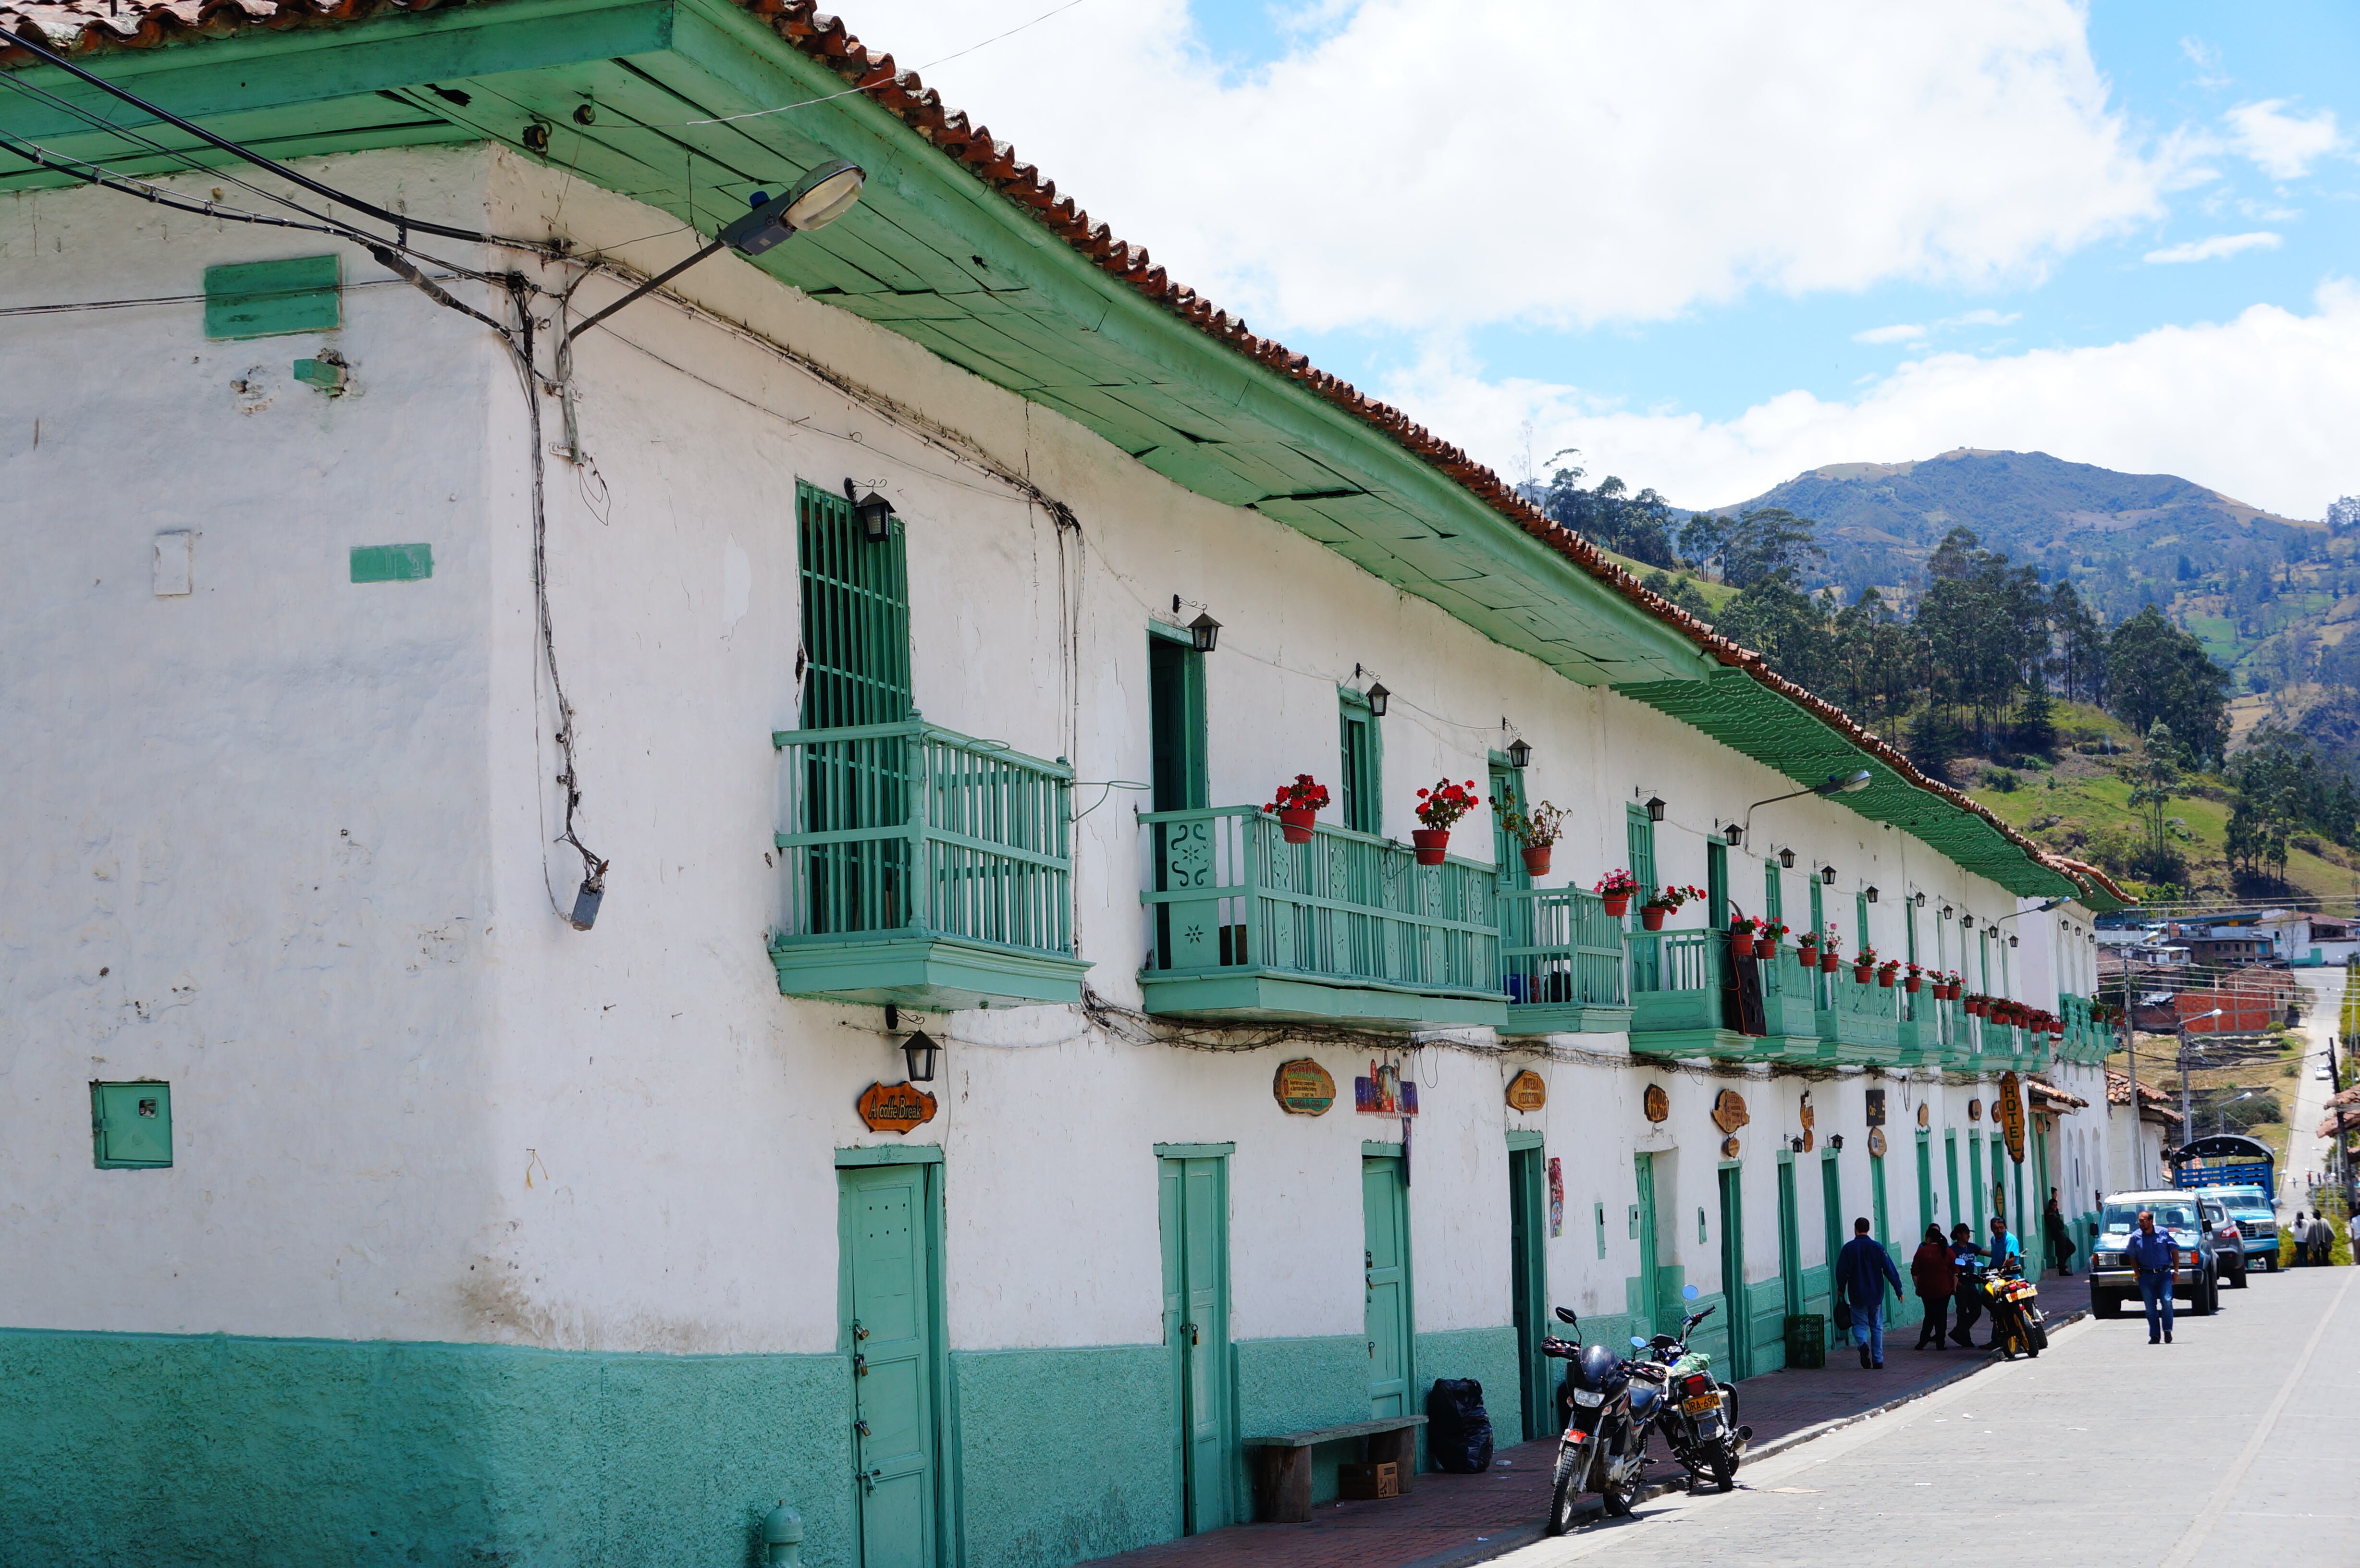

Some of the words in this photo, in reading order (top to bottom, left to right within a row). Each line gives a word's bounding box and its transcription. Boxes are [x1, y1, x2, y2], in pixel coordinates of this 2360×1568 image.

[868, 1094, 877, 1119] A
[879, 1095, 898, 1119] coffe
[898, 1094, 922, 1120] Break
[2004, 1086, 2021, 1152] HOTEL
